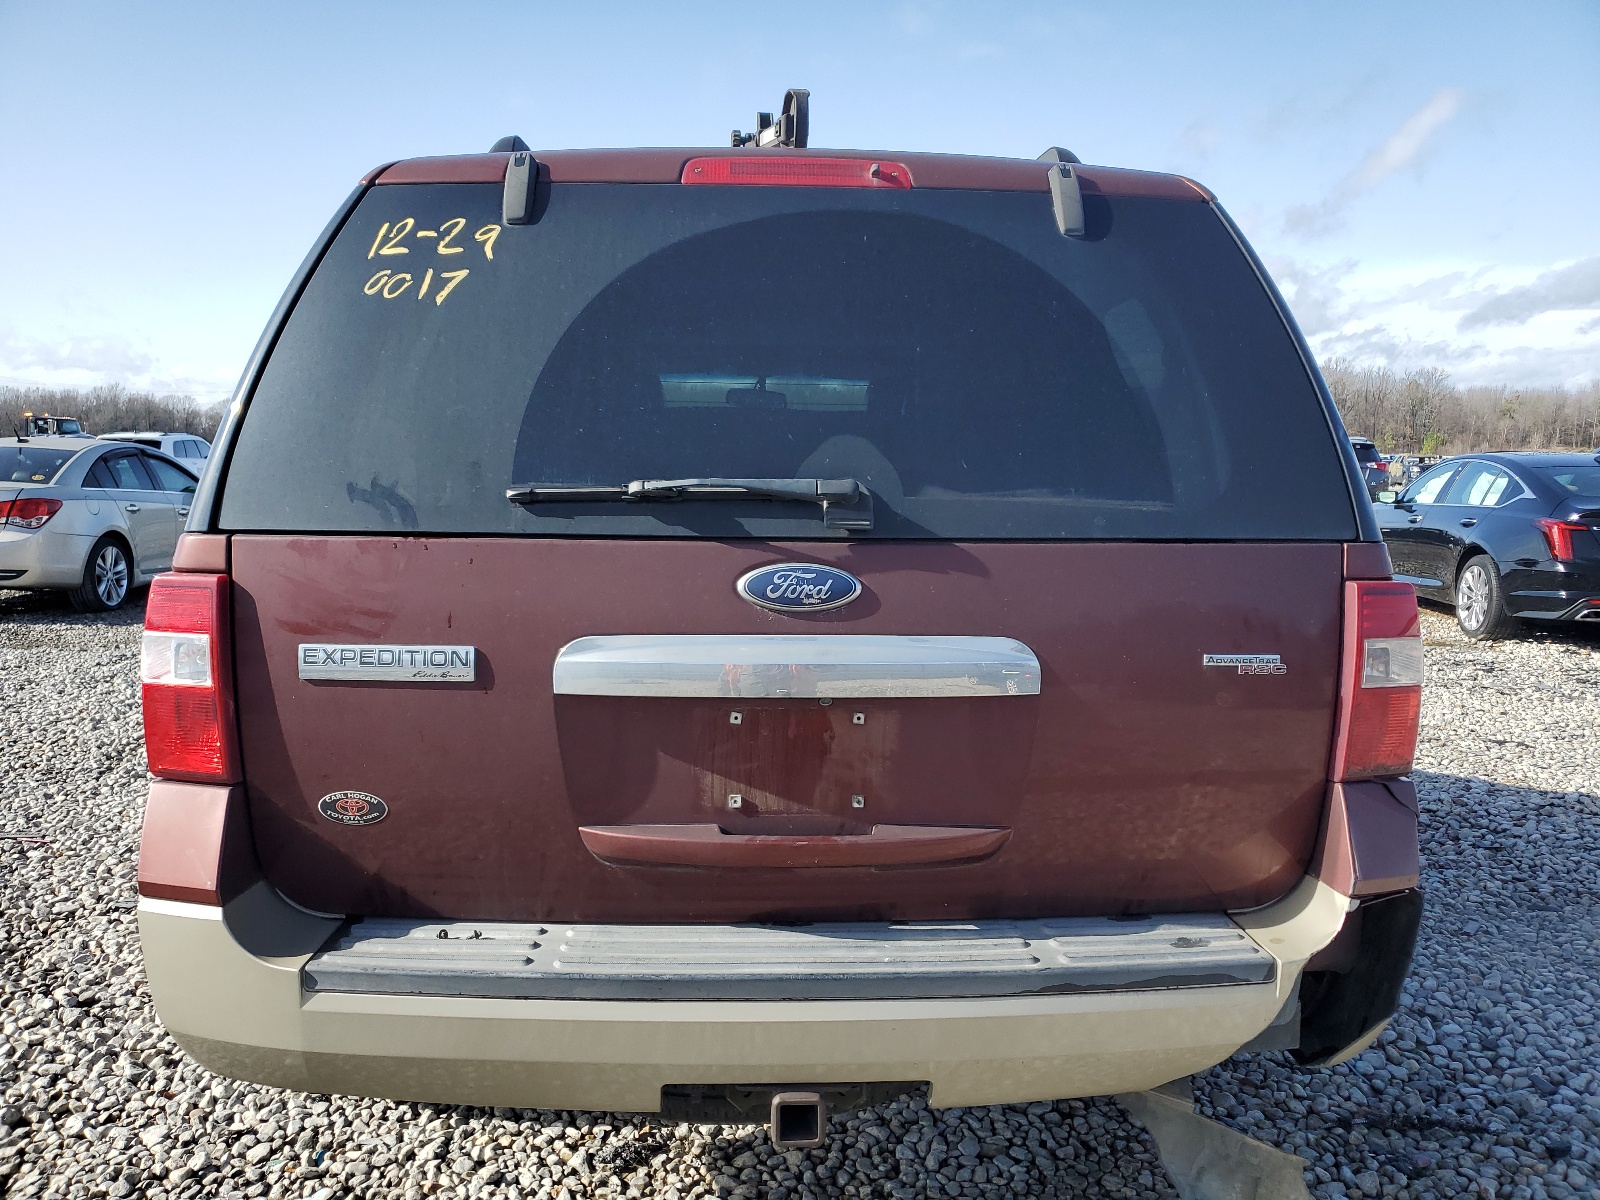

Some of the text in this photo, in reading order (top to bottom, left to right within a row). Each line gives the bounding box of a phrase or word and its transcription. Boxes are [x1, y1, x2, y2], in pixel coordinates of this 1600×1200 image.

[367, 217, 502, 262] 12-29
[363, 267, 470, 306] 0017
[766, 571, 834, 599] Ford
[302, 647, 471, 668] EXPEDITION
[1238, 664, 1287, 675] RSC
[325, 792, 379, 805] CARL HOGAN
